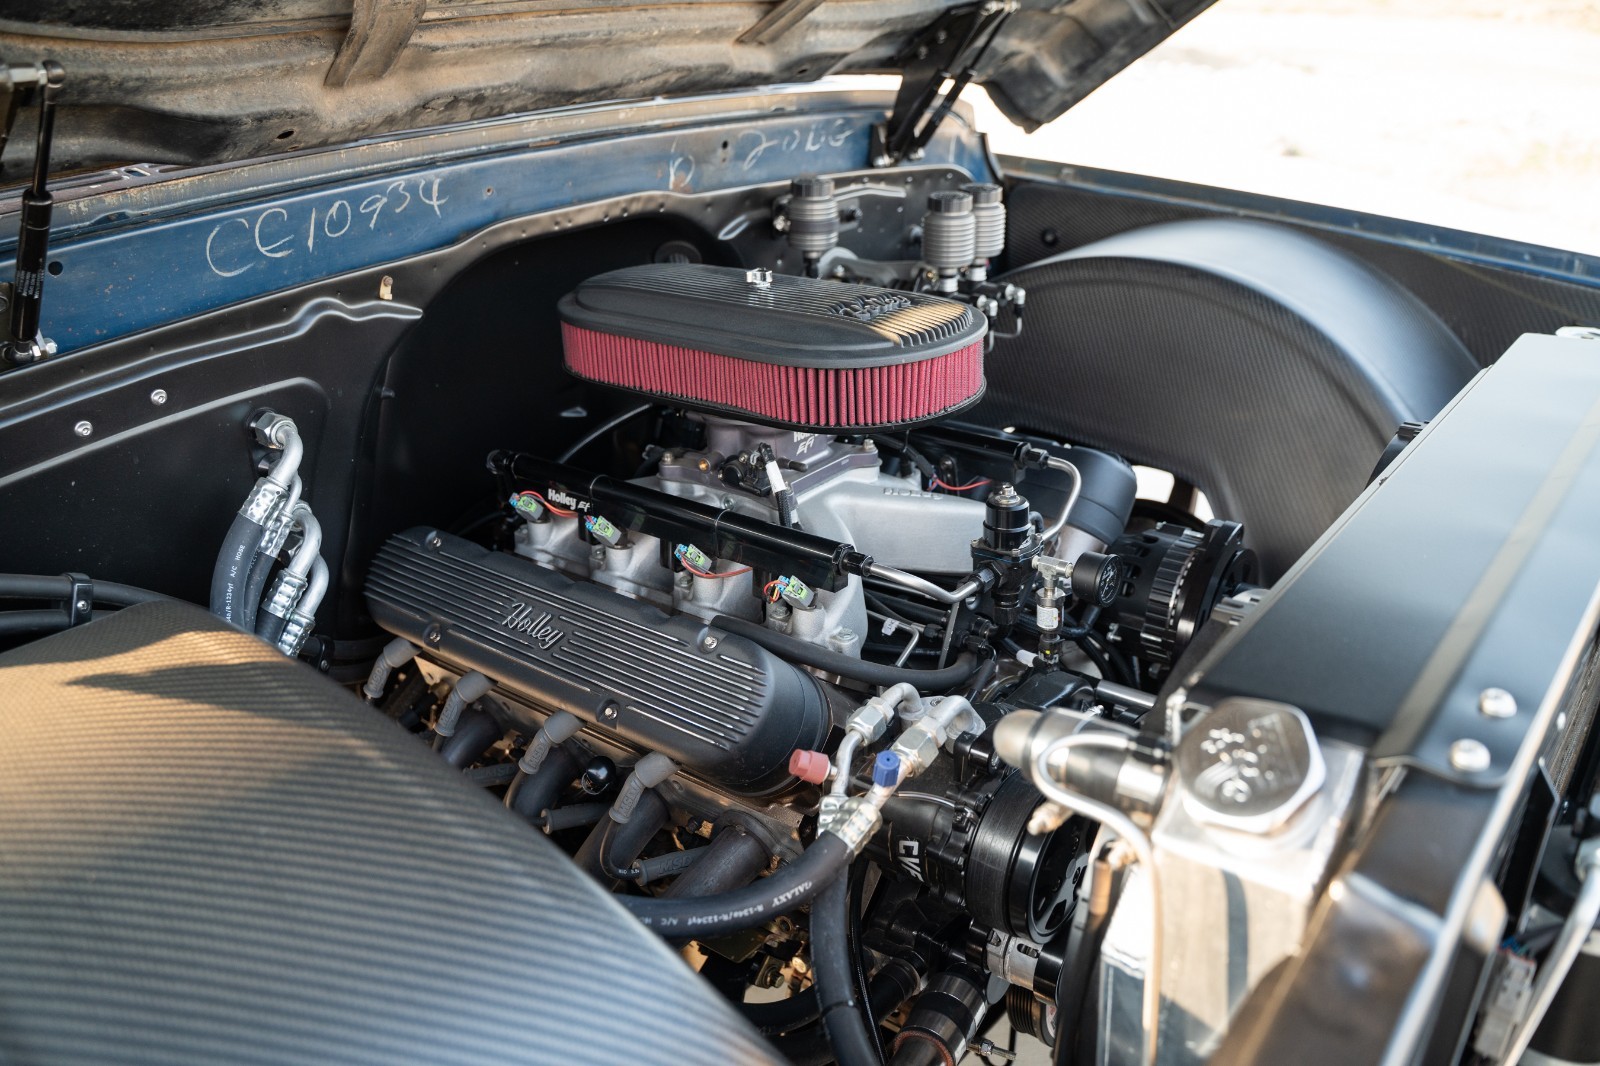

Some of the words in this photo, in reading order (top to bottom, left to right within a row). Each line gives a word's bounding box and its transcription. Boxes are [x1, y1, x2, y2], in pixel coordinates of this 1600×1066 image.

[547, 488, 577, 511] Holley
[230, 565, 238, 578] A/C
[502, 602, 564, 649] Holley
[772, 880, 812, 907] GALAXY
